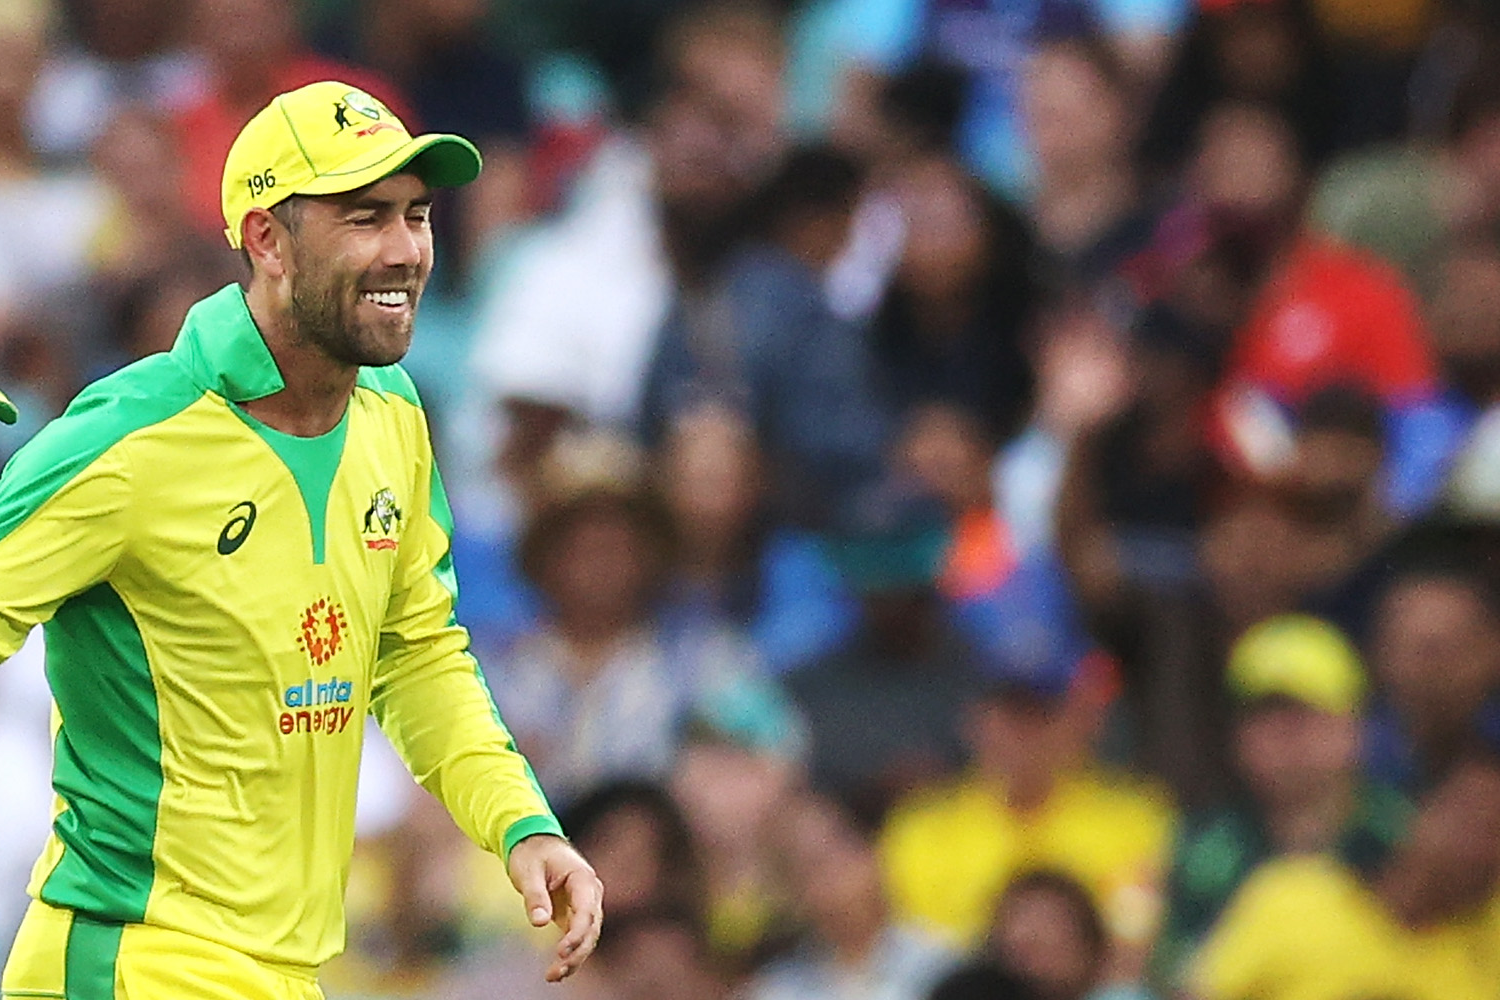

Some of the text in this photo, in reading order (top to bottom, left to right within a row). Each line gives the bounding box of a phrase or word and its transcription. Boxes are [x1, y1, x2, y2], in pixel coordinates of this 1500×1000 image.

[248, 168, 276, 198] 196
[285, 676, 352, 707] alnta
[280, 706, 354, 735] energy
